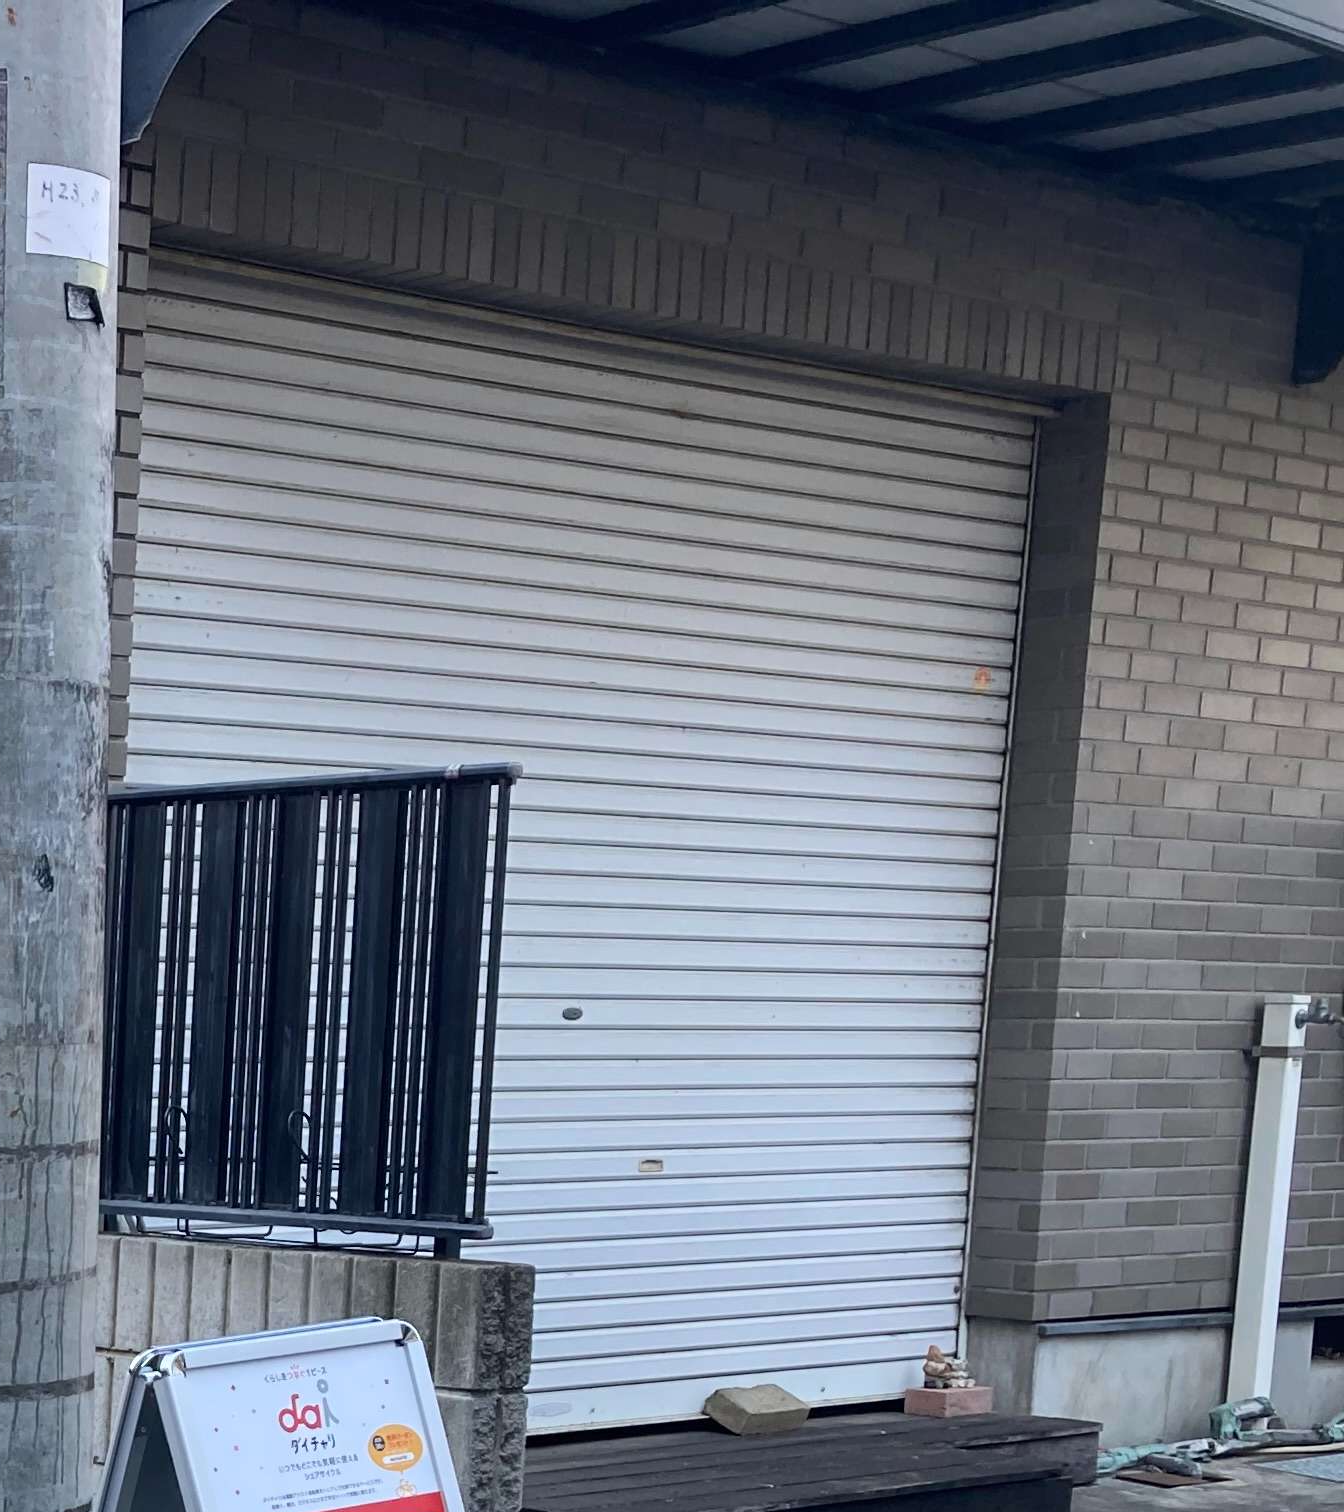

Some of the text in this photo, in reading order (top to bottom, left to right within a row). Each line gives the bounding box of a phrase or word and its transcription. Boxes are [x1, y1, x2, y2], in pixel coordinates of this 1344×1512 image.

[290, 1434, 336, 1454] ダイチャリ
[304, 1469, 342, 1481] シェアサイクル
